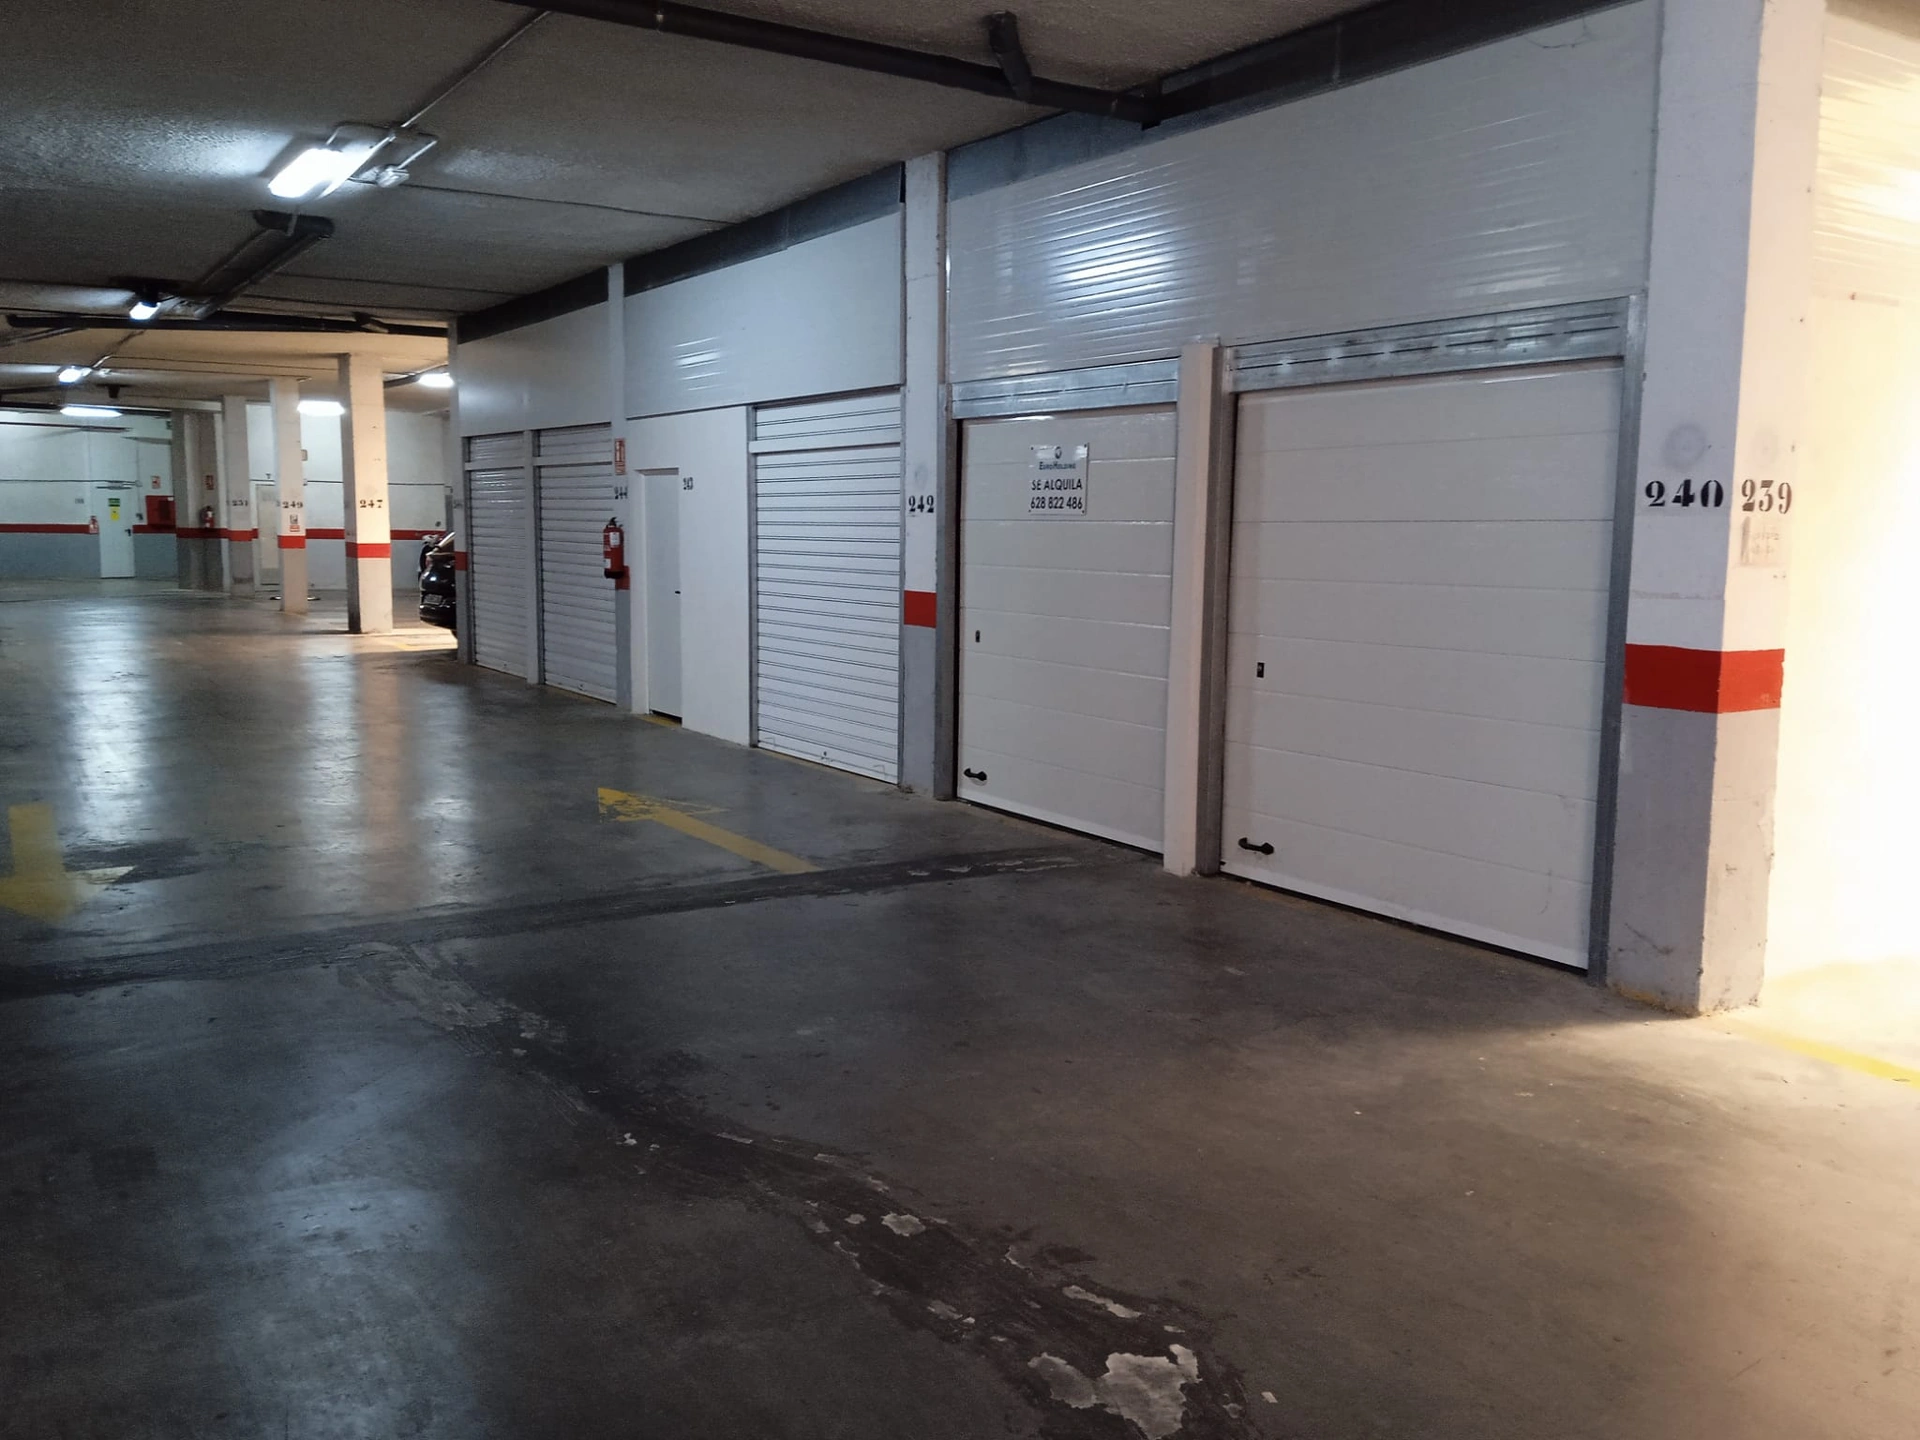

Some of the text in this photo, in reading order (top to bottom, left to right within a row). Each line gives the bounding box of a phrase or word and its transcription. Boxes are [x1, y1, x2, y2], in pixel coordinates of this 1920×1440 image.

[1031, 478, 1083, 491] SE ALQUILA
[614, 486, 628, 499] 244
[1645, 478, 1724, 507] 240
[1741, 478, 1793, 514] 239
[360, 499, 383, 508] 247
[908, 494, 934, 513] 242
[1030, 496, 1083, 509] 628 822 486
